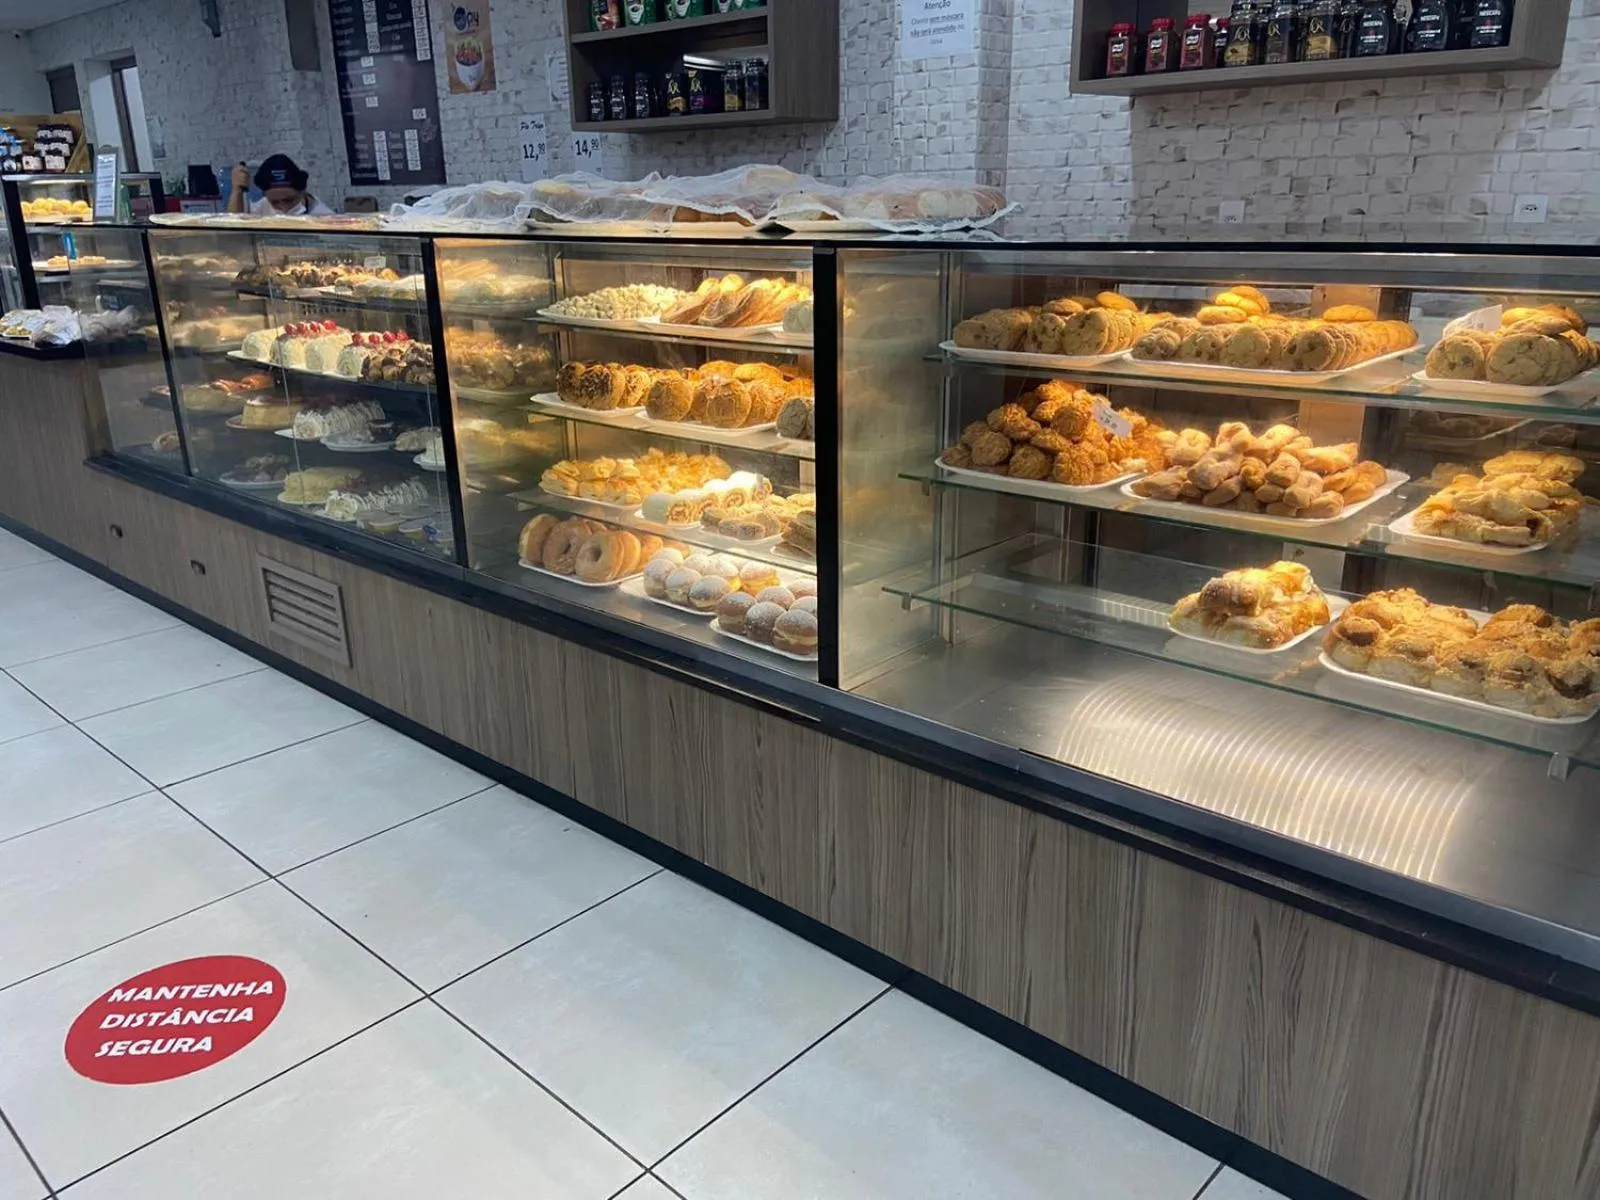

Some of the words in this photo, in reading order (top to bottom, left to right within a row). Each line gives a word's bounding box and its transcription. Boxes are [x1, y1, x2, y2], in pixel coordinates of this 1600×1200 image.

[107, 980, 273, 1003] MANTENHA
[99, 1007, 254, 1029] DISTÂNCIA
[94, 1036, 213, 1058] SEGURA
